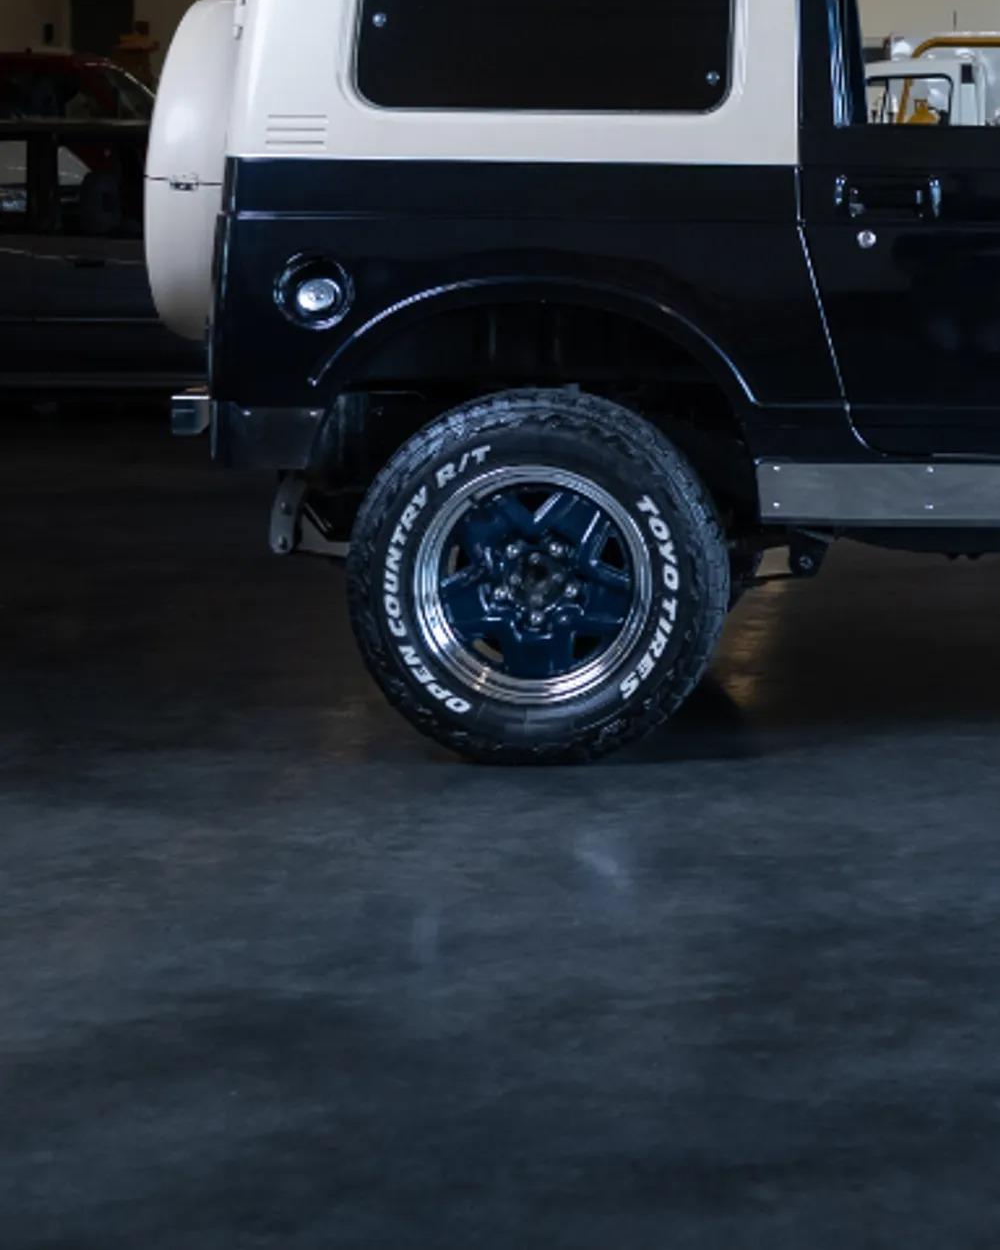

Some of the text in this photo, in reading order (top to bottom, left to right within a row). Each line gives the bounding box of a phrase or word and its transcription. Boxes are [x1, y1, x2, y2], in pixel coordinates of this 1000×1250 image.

[383, 446, 491, 713] OPEN COUNTRY R/T
[619, 494, 679, 699] TOYO TIRES
